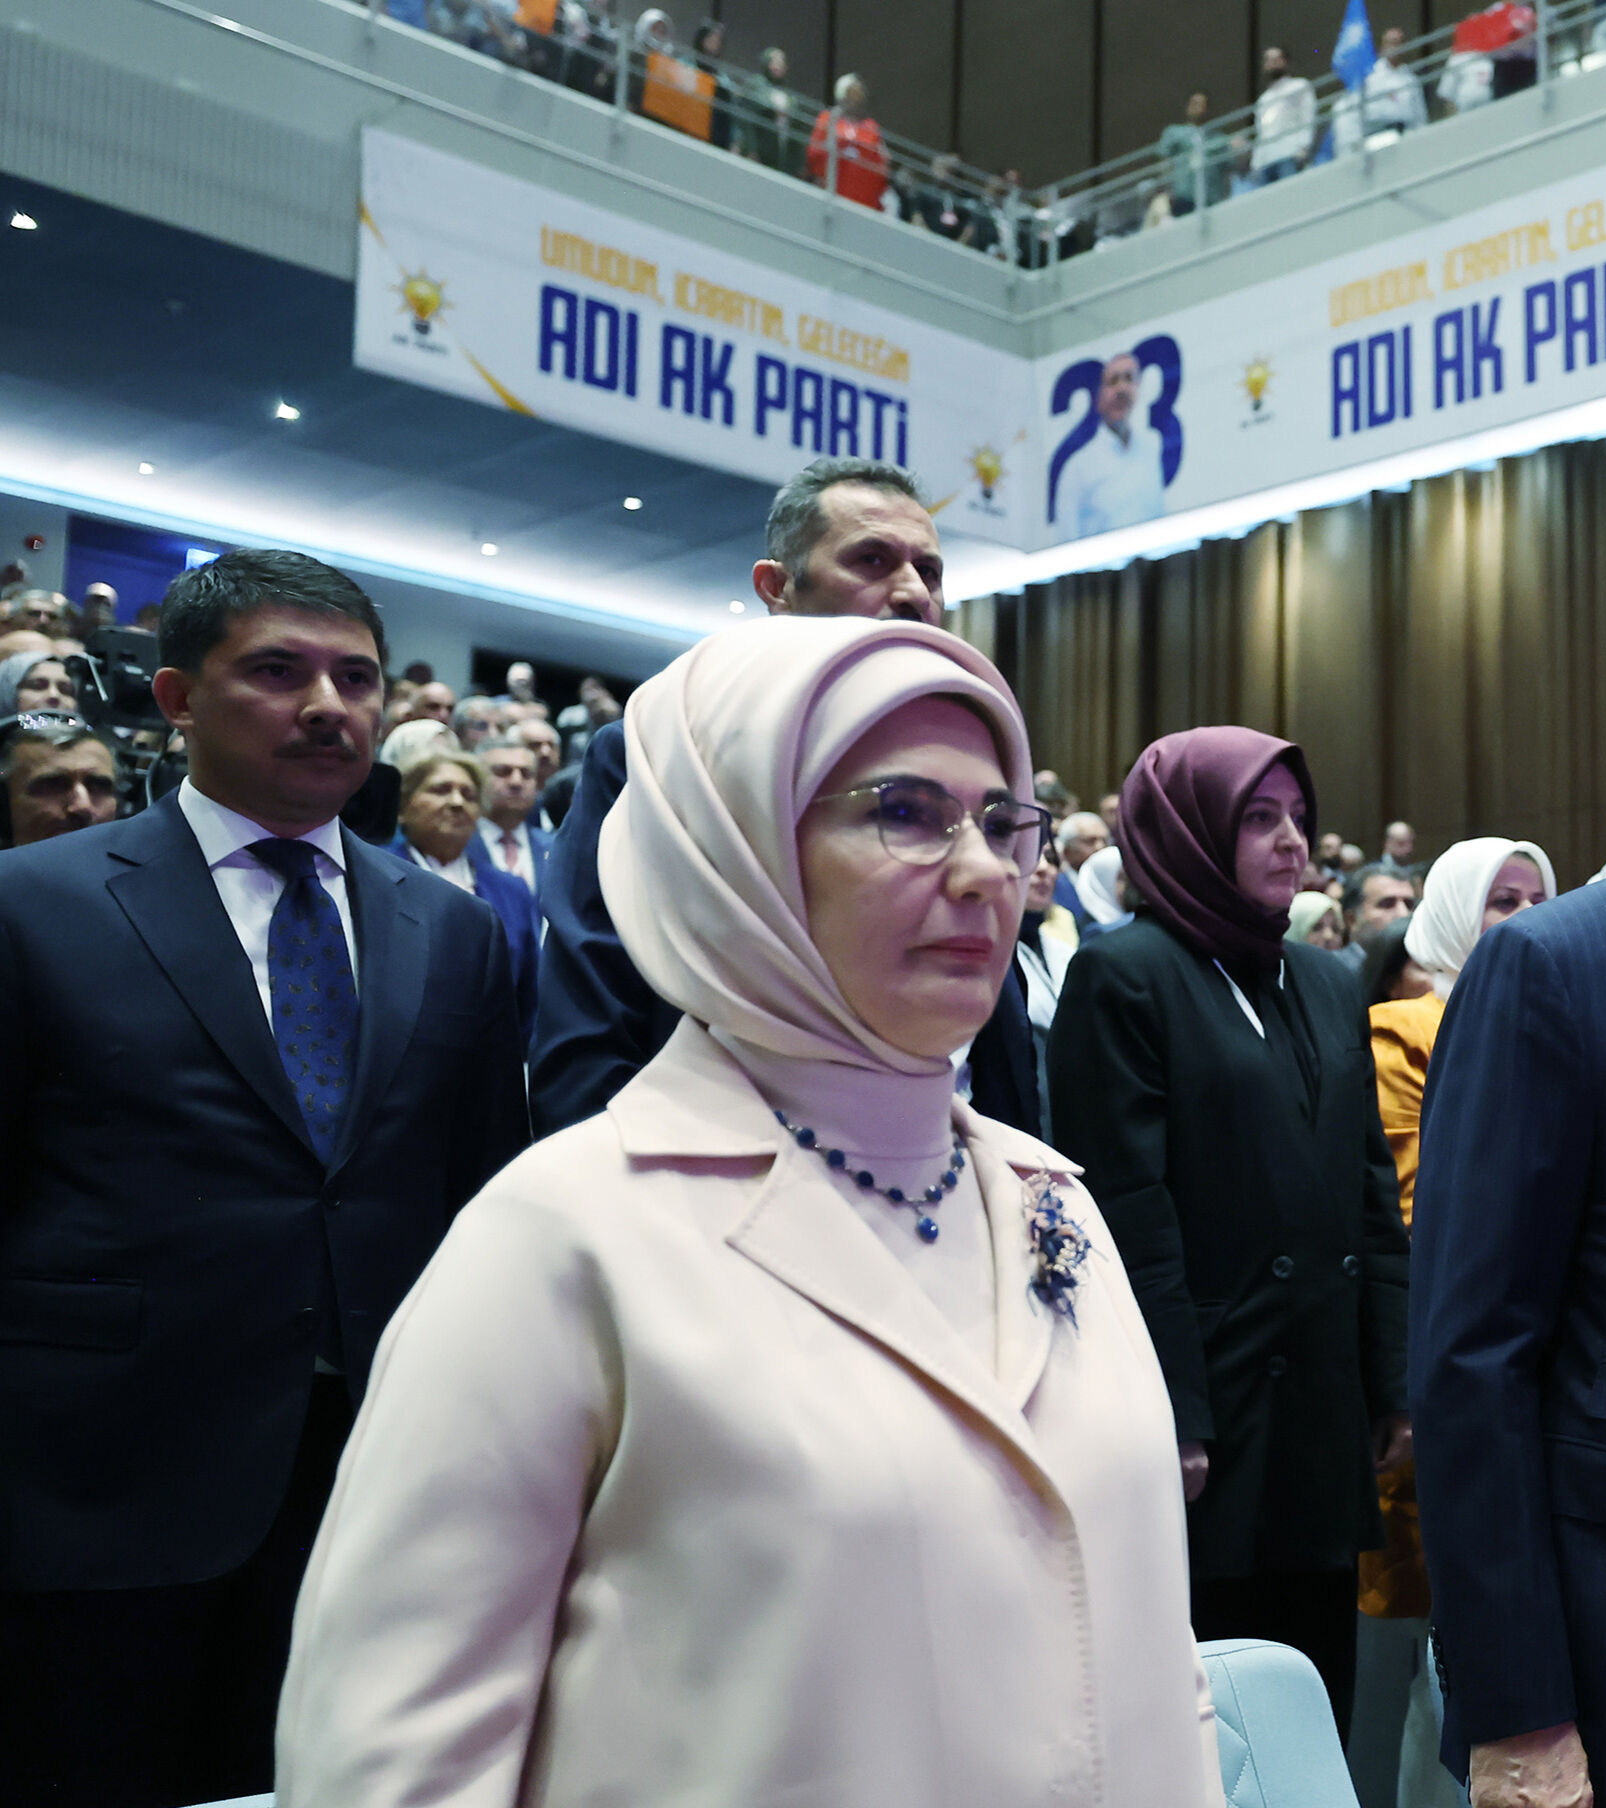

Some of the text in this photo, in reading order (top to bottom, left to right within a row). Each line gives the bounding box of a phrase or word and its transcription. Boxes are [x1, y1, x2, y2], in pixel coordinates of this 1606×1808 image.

[538, 283, 908, 469] ADI AK PARTİ
[1047, 334, 1183, 524] 23
[1331, 324, 1412, 438] ADI
[1434, 296, 1503, 410] AK
